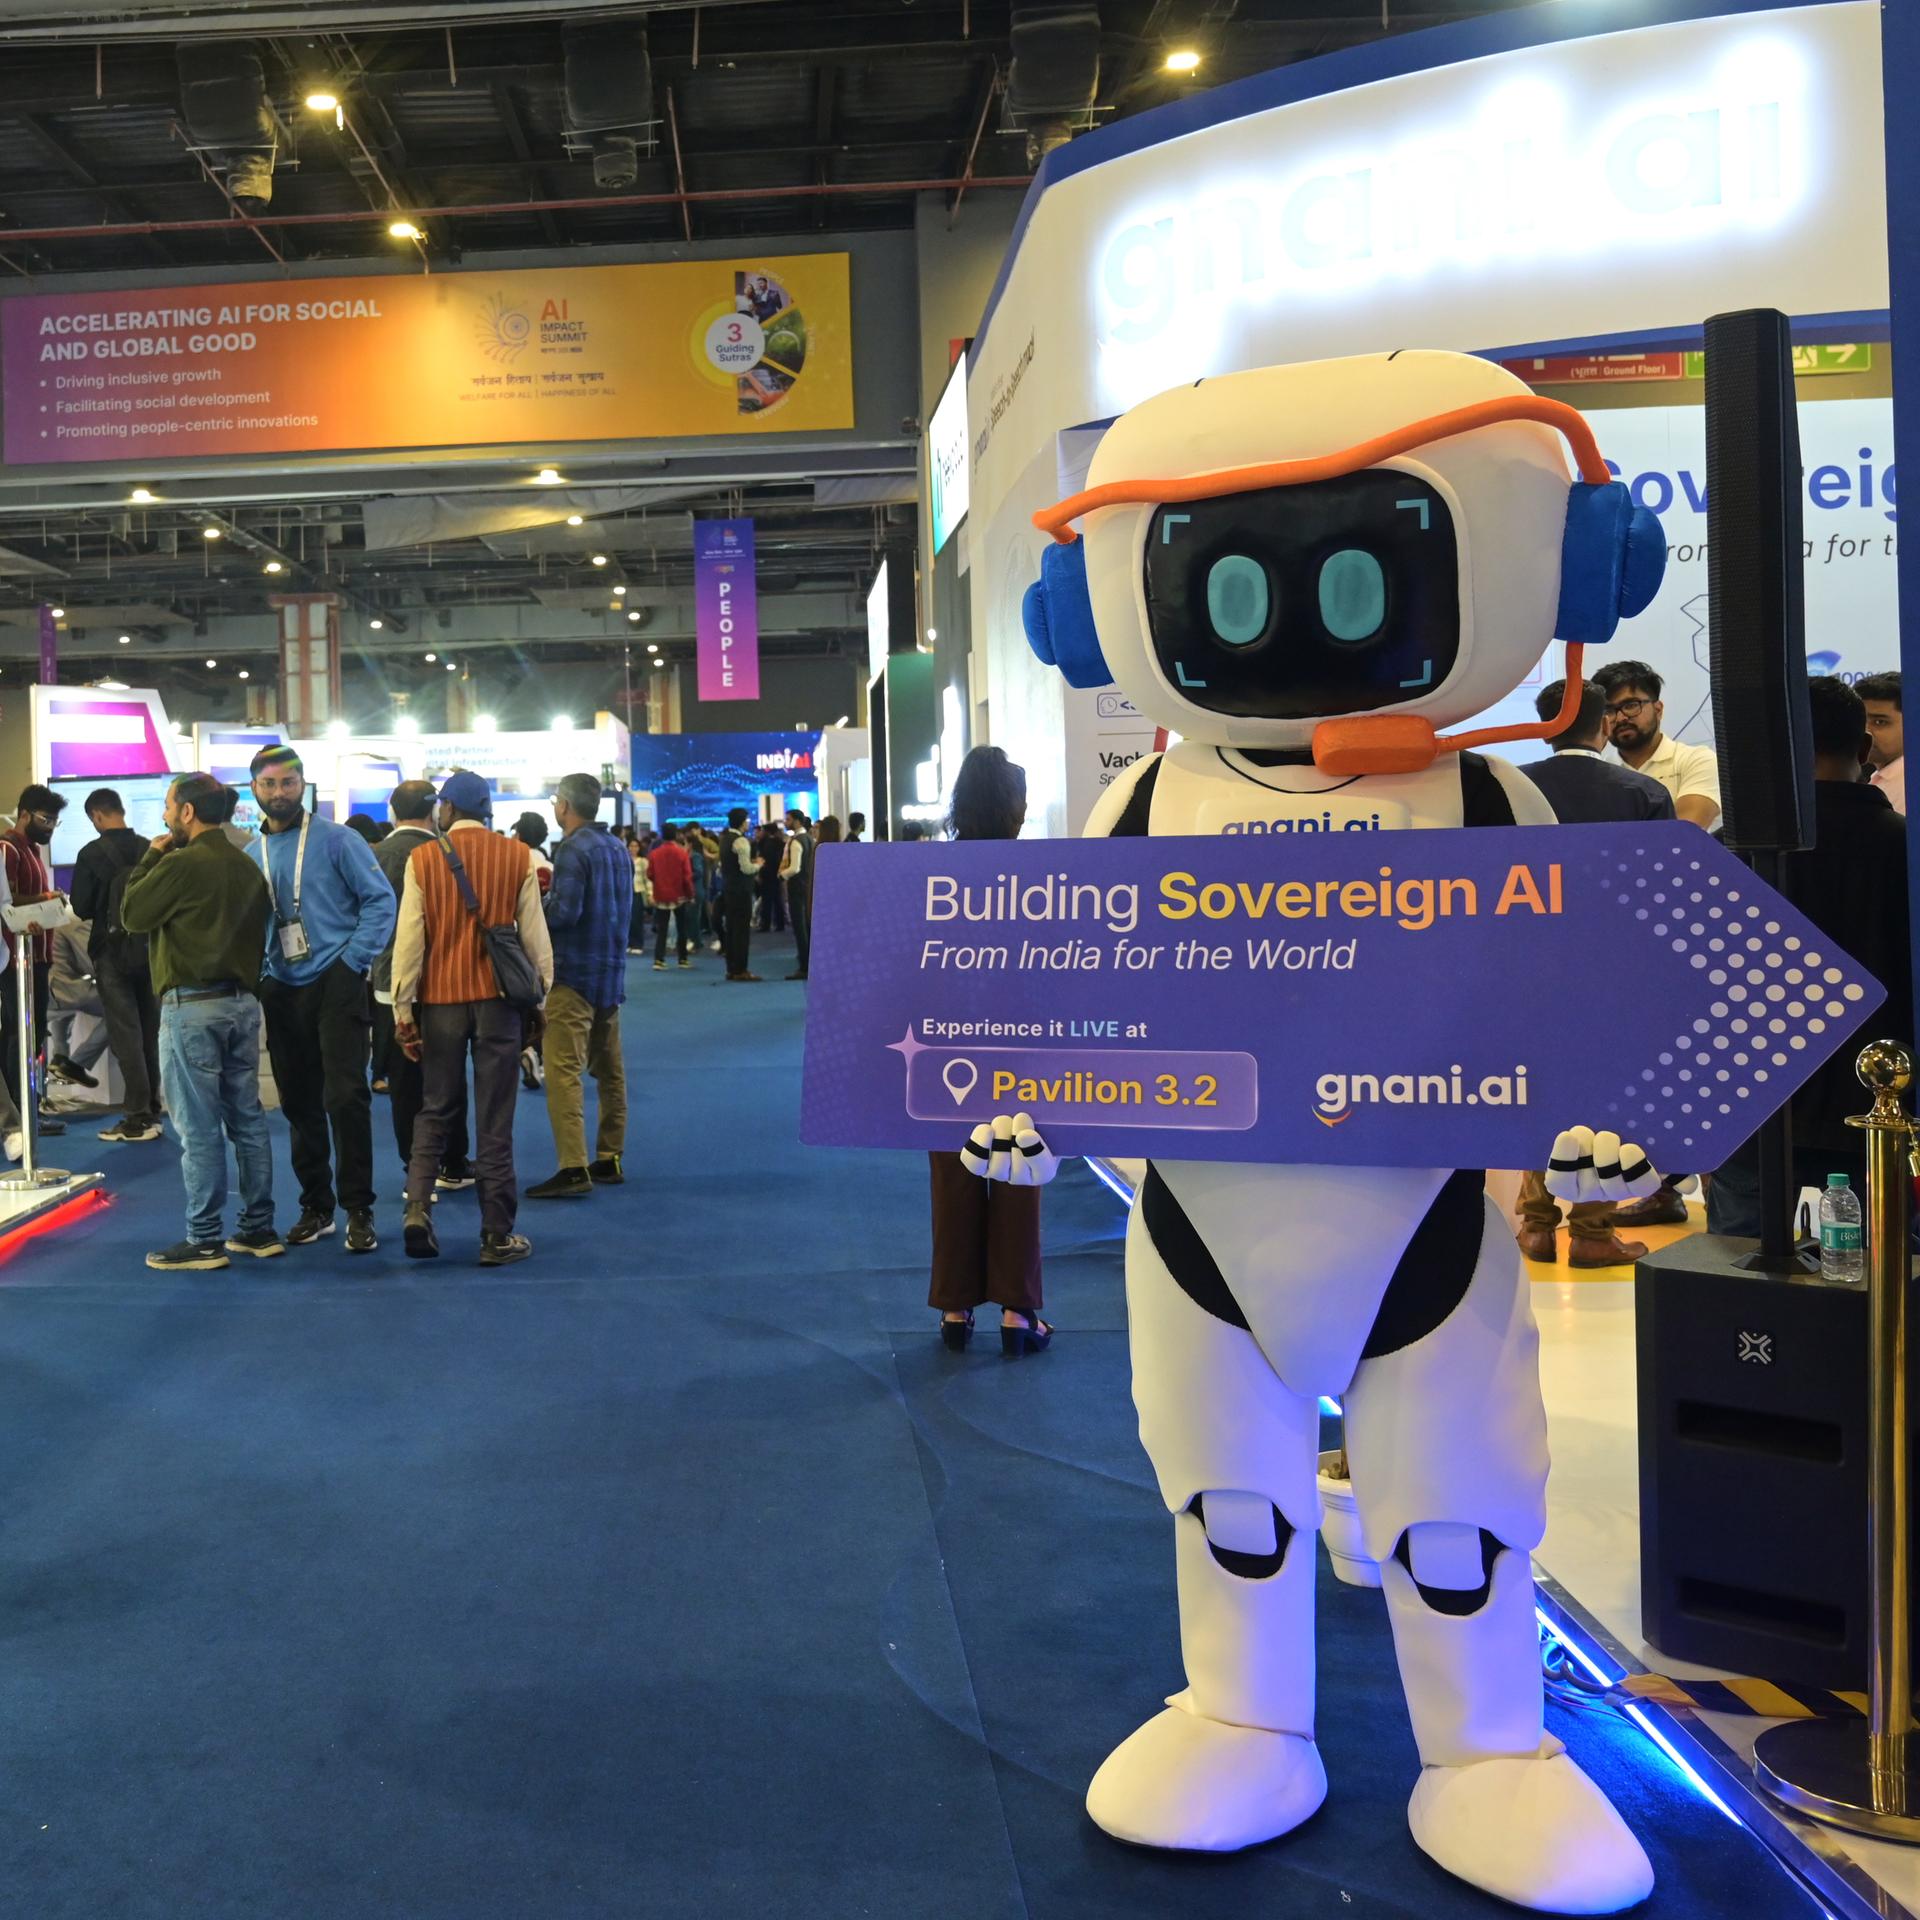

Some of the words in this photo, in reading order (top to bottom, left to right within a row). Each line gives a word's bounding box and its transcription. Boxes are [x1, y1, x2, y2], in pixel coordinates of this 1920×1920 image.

[1101, 55, 1781, 344] gnaniai
[40, 308, 212, 335] ACCELERATING
[217, 306, 240, 324] AI
[246, 304, 291, 323] FOR
[296, 299, 382, 321] SOCIAL
[541, 298, 568, 321] AI
[540, 321, 585, 333] IMPACT
[540, 332, 588, 344] SUMMIT
[727, 323, 742, 343] 3
[40, 342, 88, 362] AND
[94, 335, 183, 358] GLOBAL
[188, 332, 256, 354] GOOD
[716, 344, 755, 355] Guiding
[719, 353, 752, 363] Sutras
[56, 375, 104, 390] Driving
[108, 370, 169, 386] inclusive
[172, 367, 221, 385] growth
[1603, 365, 1636, 376] Ground
[1638, 364, 1666, 375] Floor)
[56, 397, 132, 414] Facilitating
[135, 395, 176, 410] social
[179, 390, 271, 409] development
[56, 422, 128, 439] Promoting
[131, 416, 234, 437] people-centric
[237, 413, 318, 430] innovations
[1824, 533, 1871, 564] for
[719, 582, 734, 687] PEOPLE
[926, 872, 1139, 933] Building
[1158, 866, 1478, 931] Sovereign
[1495, 864, 1563, 915] AI
[920, 940, 1007, 970] From
[1019, 939, 1101, 970] India
[1113, 938, 1164, 970] for
[1174, 939, 1233, 970] the
[1246, 938, 1357, 970] World
[922, 1018, 1043, 1040] Experience
[1050, 1019, 1064, 1037] it
[1070, 1020, 1119, 1038] LIVE
[1125, 1022, 1148, 1039] at
[992, 1071, 1143, 1105] Pavilion
[1154, 1073, 1218, 1107] 3.2
[1314, 1064, 1529, 1114] gnani.ai
